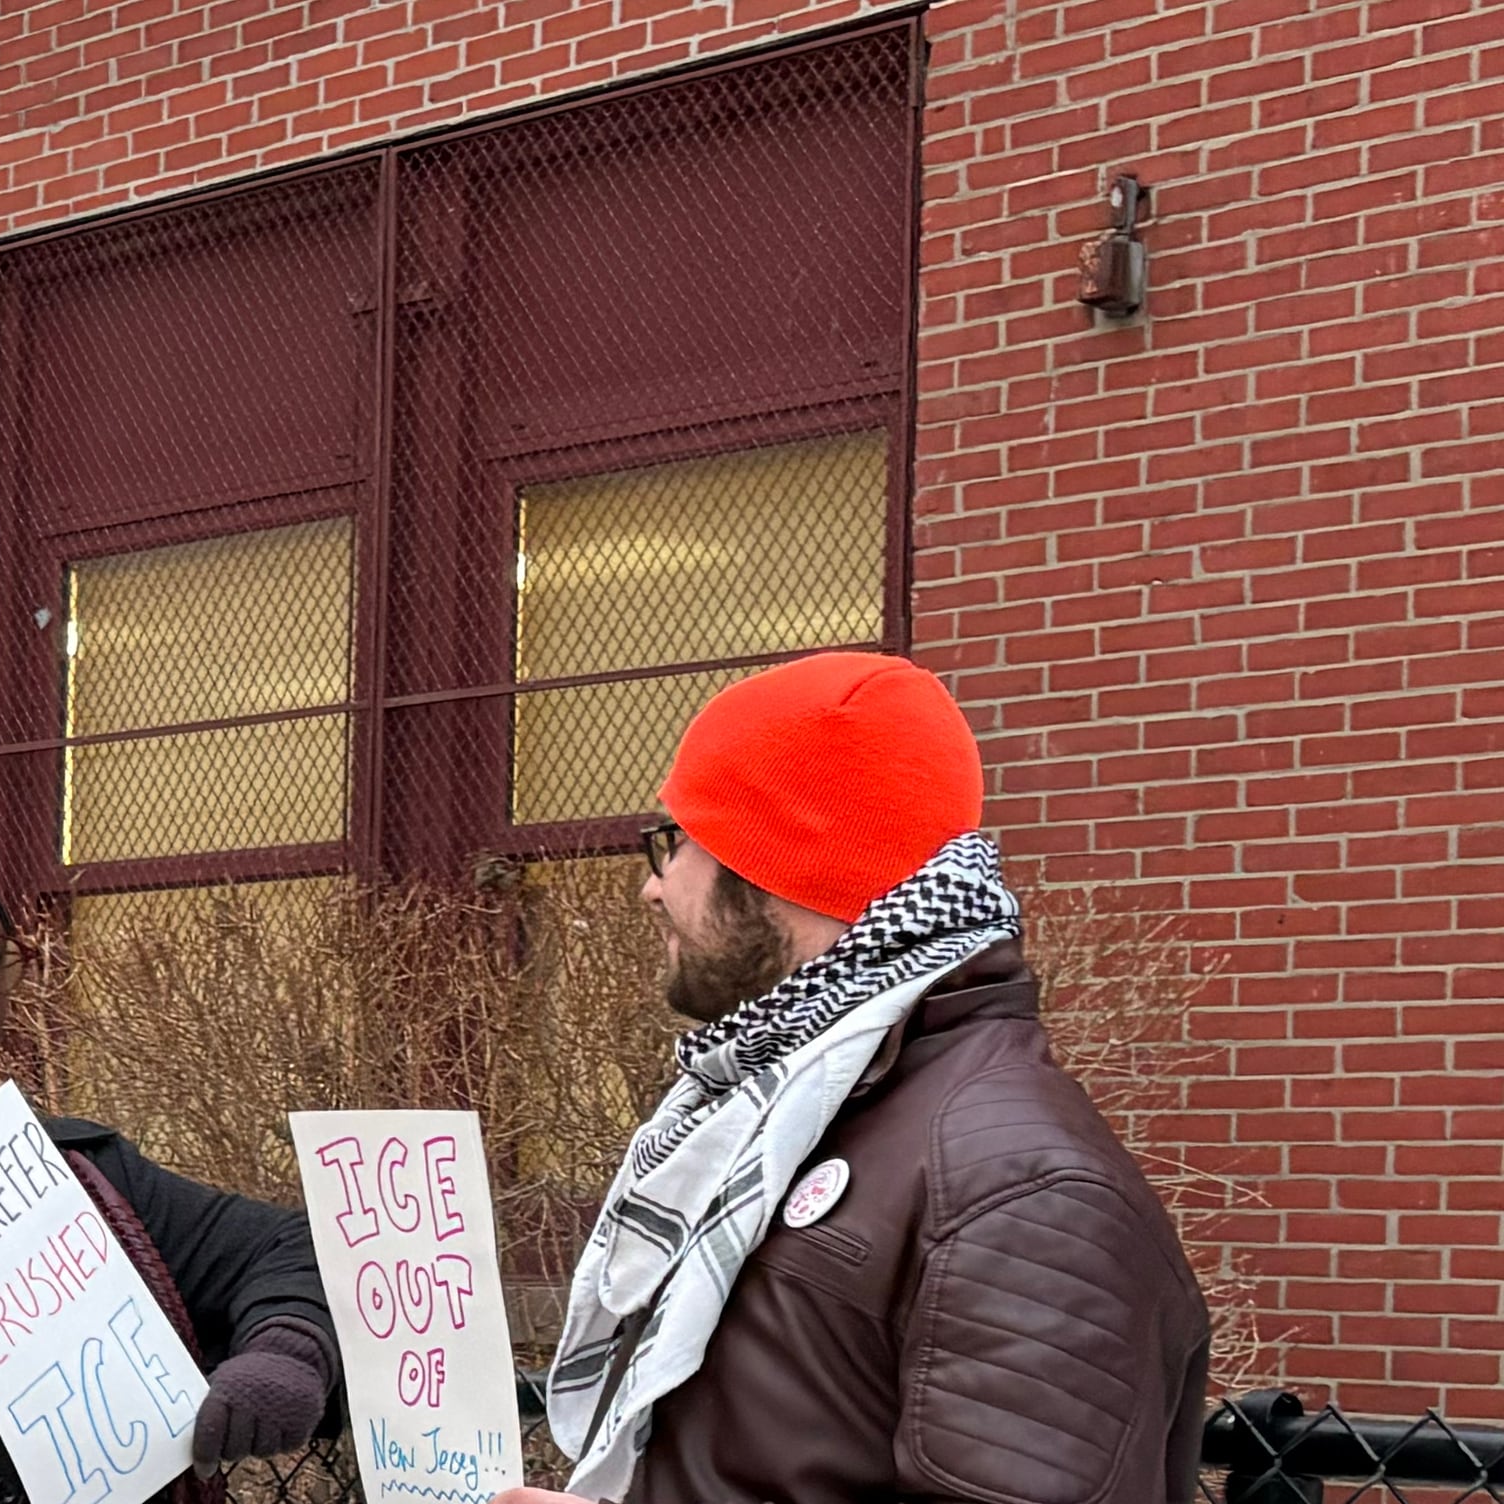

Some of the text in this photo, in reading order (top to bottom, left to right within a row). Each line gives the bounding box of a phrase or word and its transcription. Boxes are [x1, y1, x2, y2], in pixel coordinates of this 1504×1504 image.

[315, 1136, 465, 1248] ICE
[356, 1253, 474, 1339] OUT
[398, 1348, 446, 1409] OF
[369, 1418, 415, 1472] New
